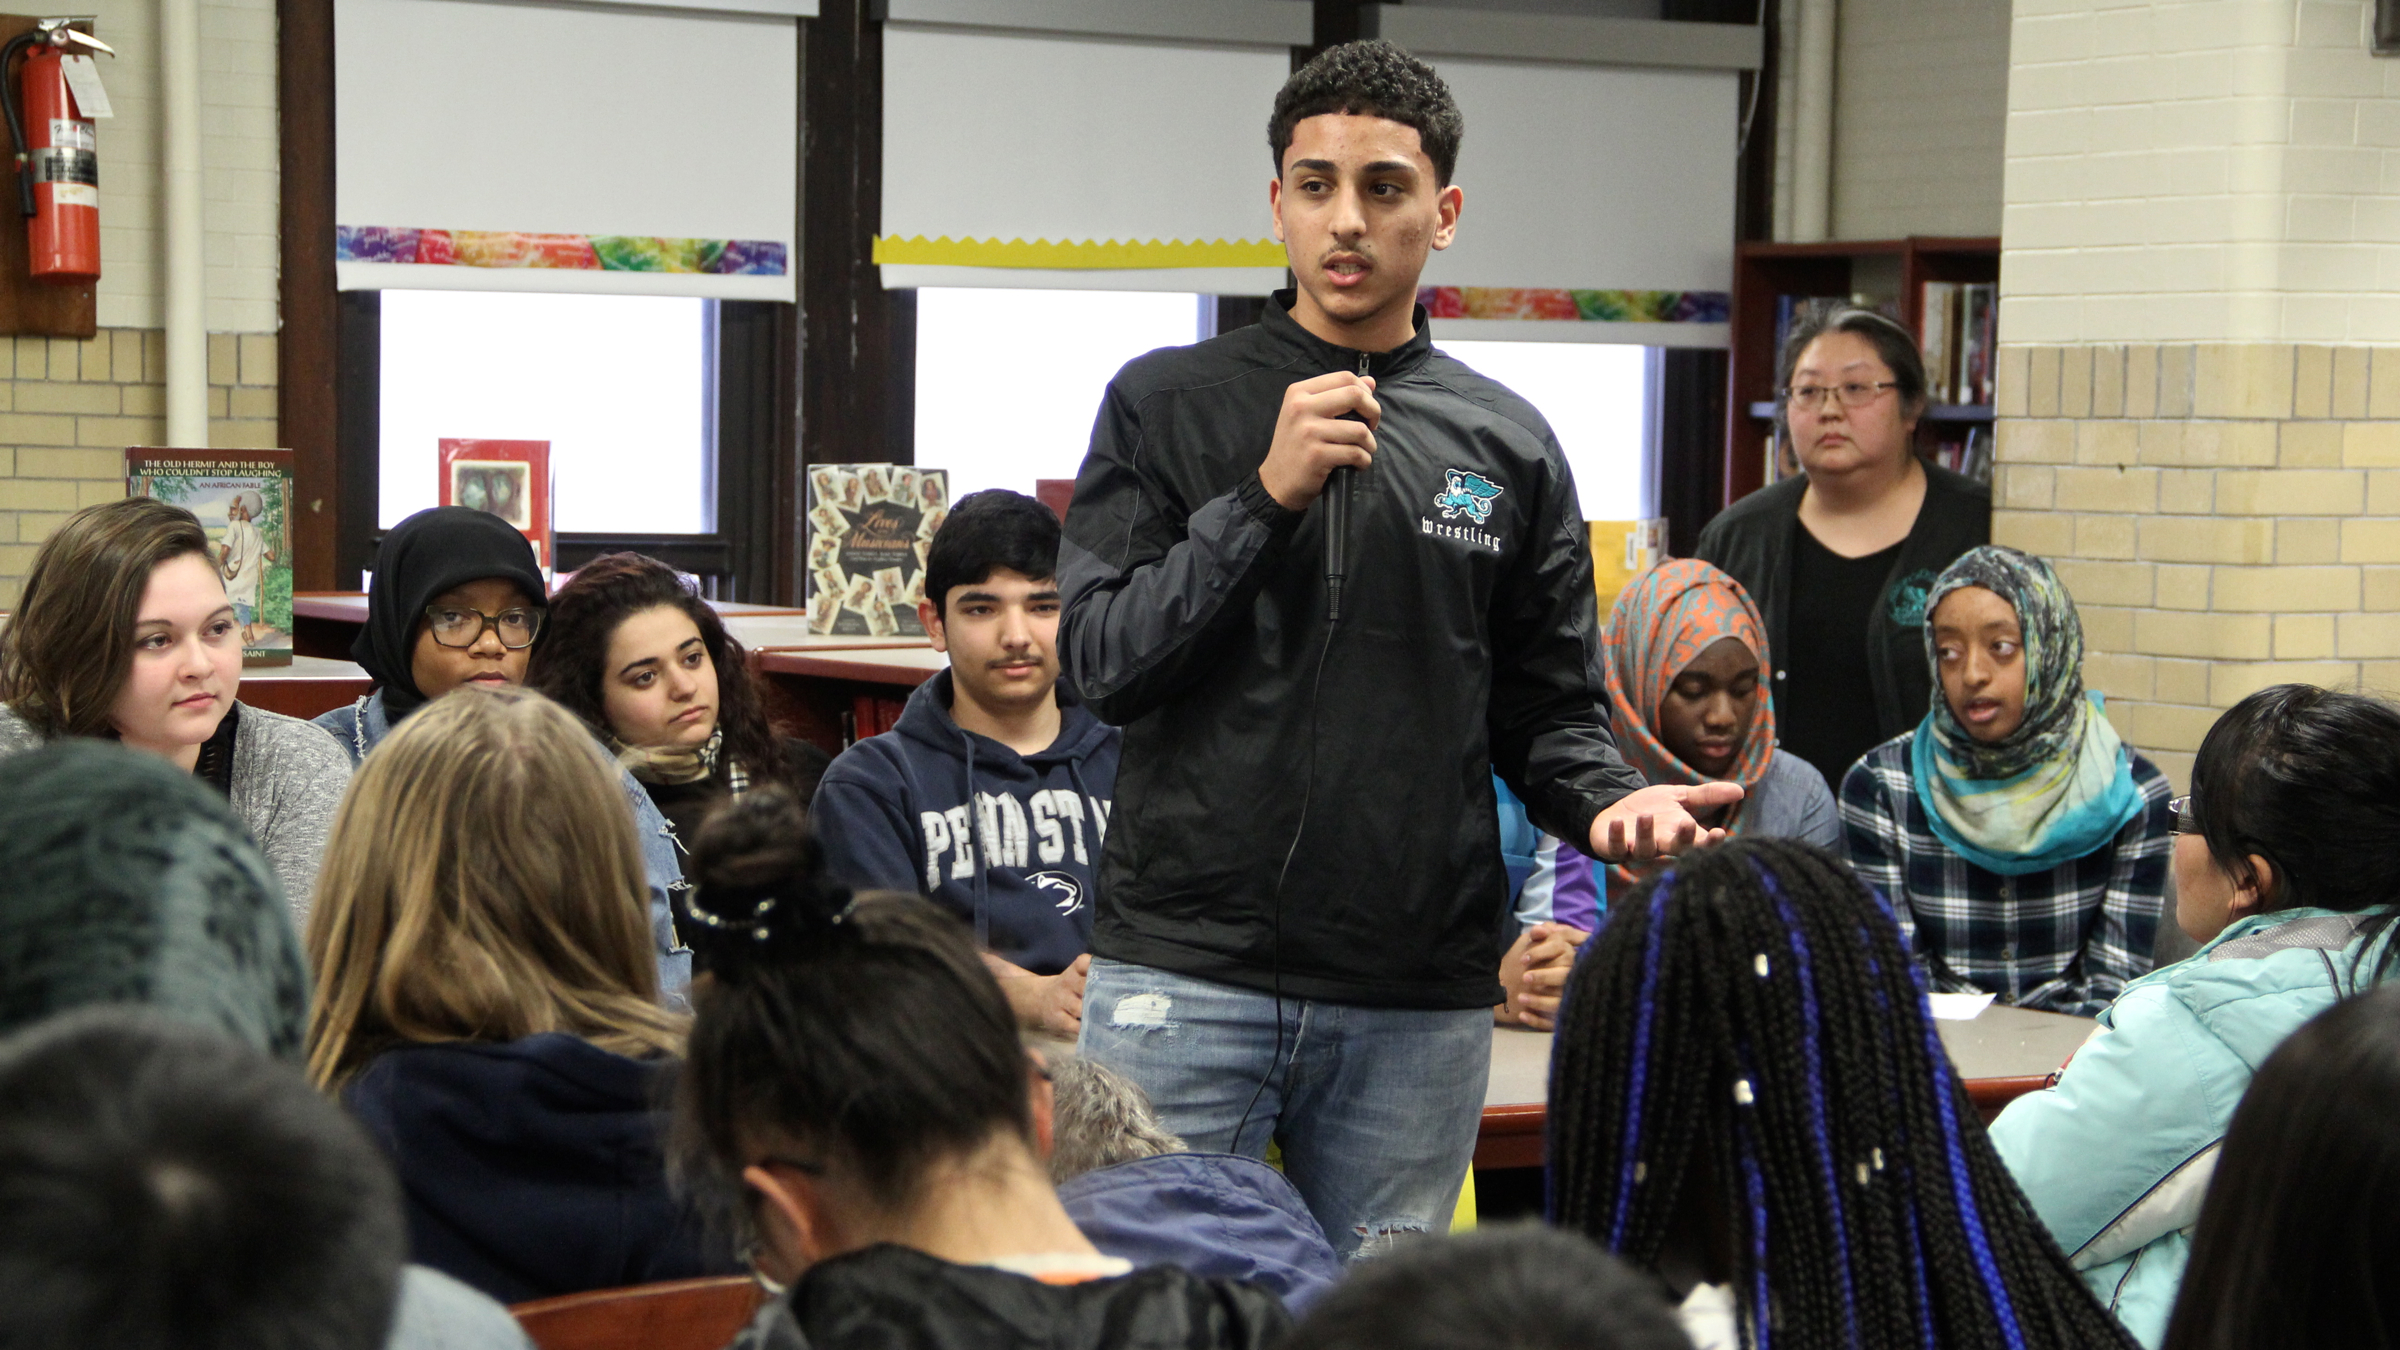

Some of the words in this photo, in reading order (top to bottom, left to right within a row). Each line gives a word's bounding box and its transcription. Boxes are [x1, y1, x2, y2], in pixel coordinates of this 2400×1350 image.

[144, 460, 161, 468] THE
[163, 460, 182, 468] OLD
[183, 460, 216, 468] HERMIT
[217, 461, 239, 469] AND
[240, 461, 256, 469] THE
[258, 461, 275, 469] BOY
[140, 468, 164, 476] WHO
[165, 468, 209, 476] COULDN'T
[211, 469, 233, 477] STOP
[234, 469, 282, 478] LAUGHING
[920, 791, 1029, 893] PENN
[1029, 789, 1112, 866] ST
